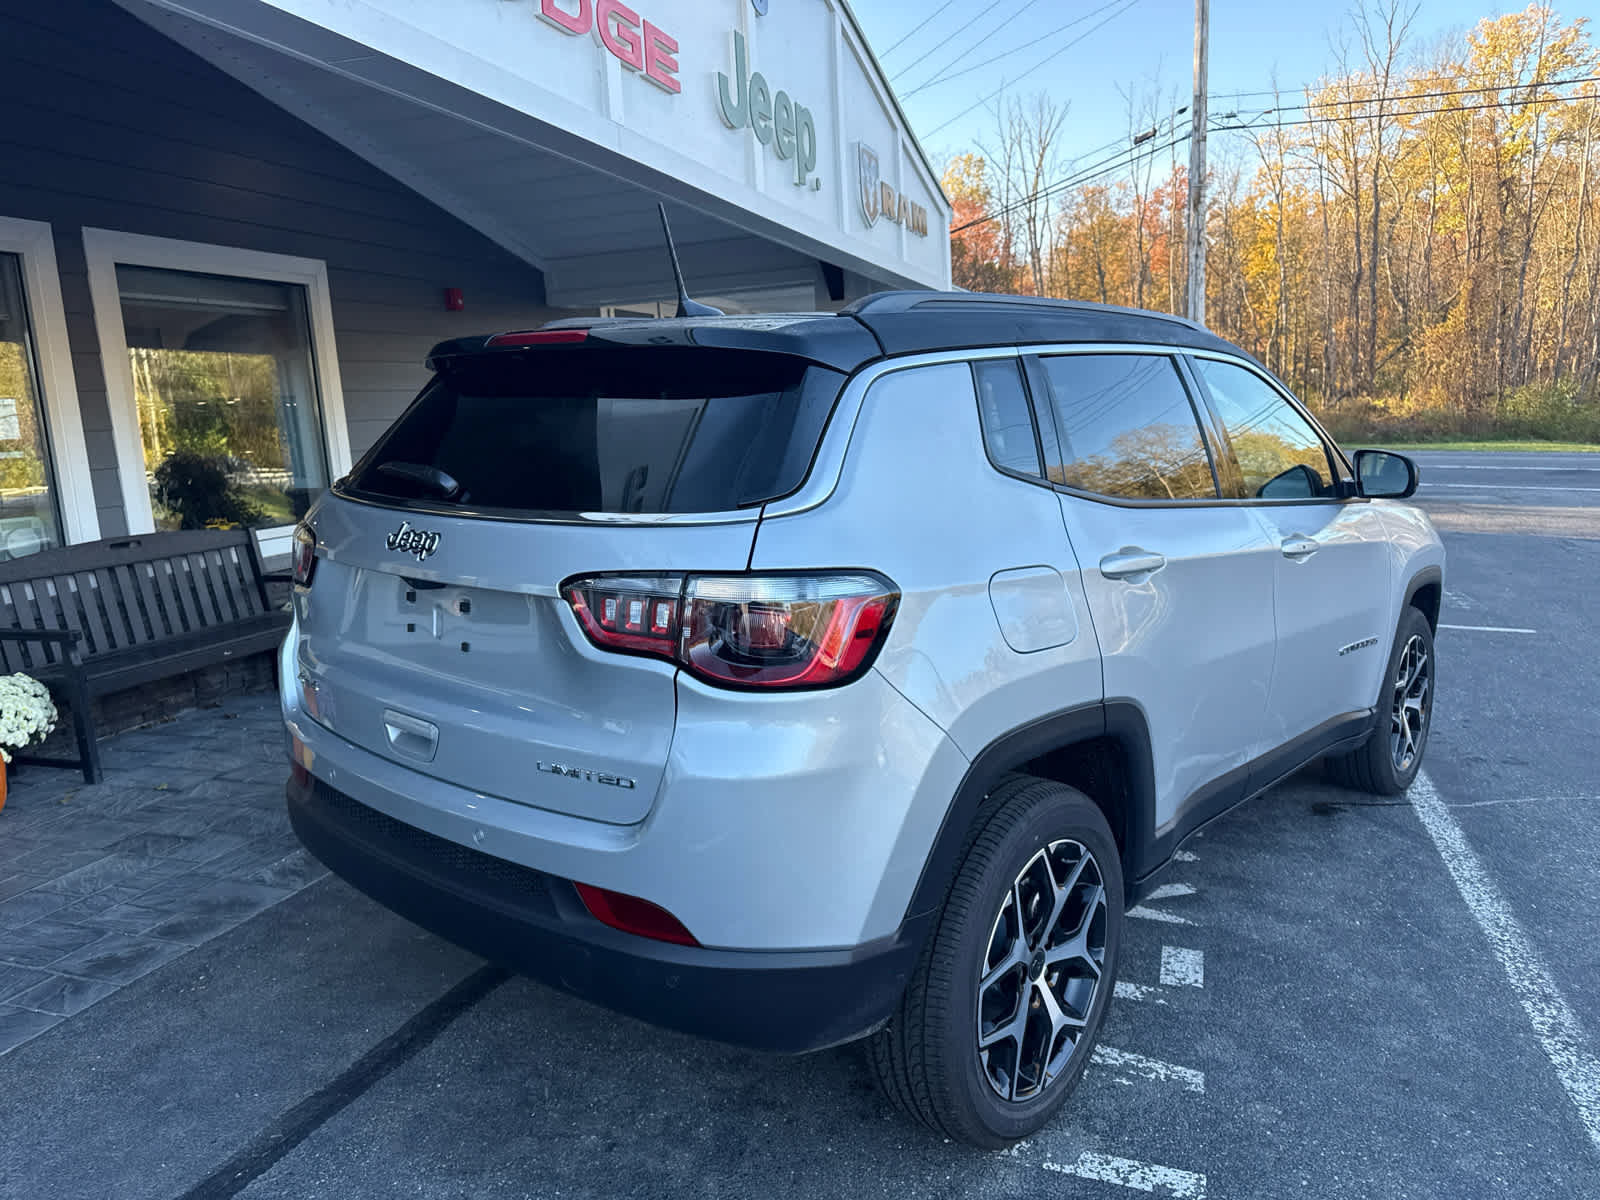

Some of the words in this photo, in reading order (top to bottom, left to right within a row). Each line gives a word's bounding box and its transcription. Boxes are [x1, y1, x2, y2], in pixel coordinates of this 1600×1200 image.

[880, 180, 928, 237] RAM
[386, 520, 441, 561] Jeep
[536, 759, 636, 789] LIMITED
